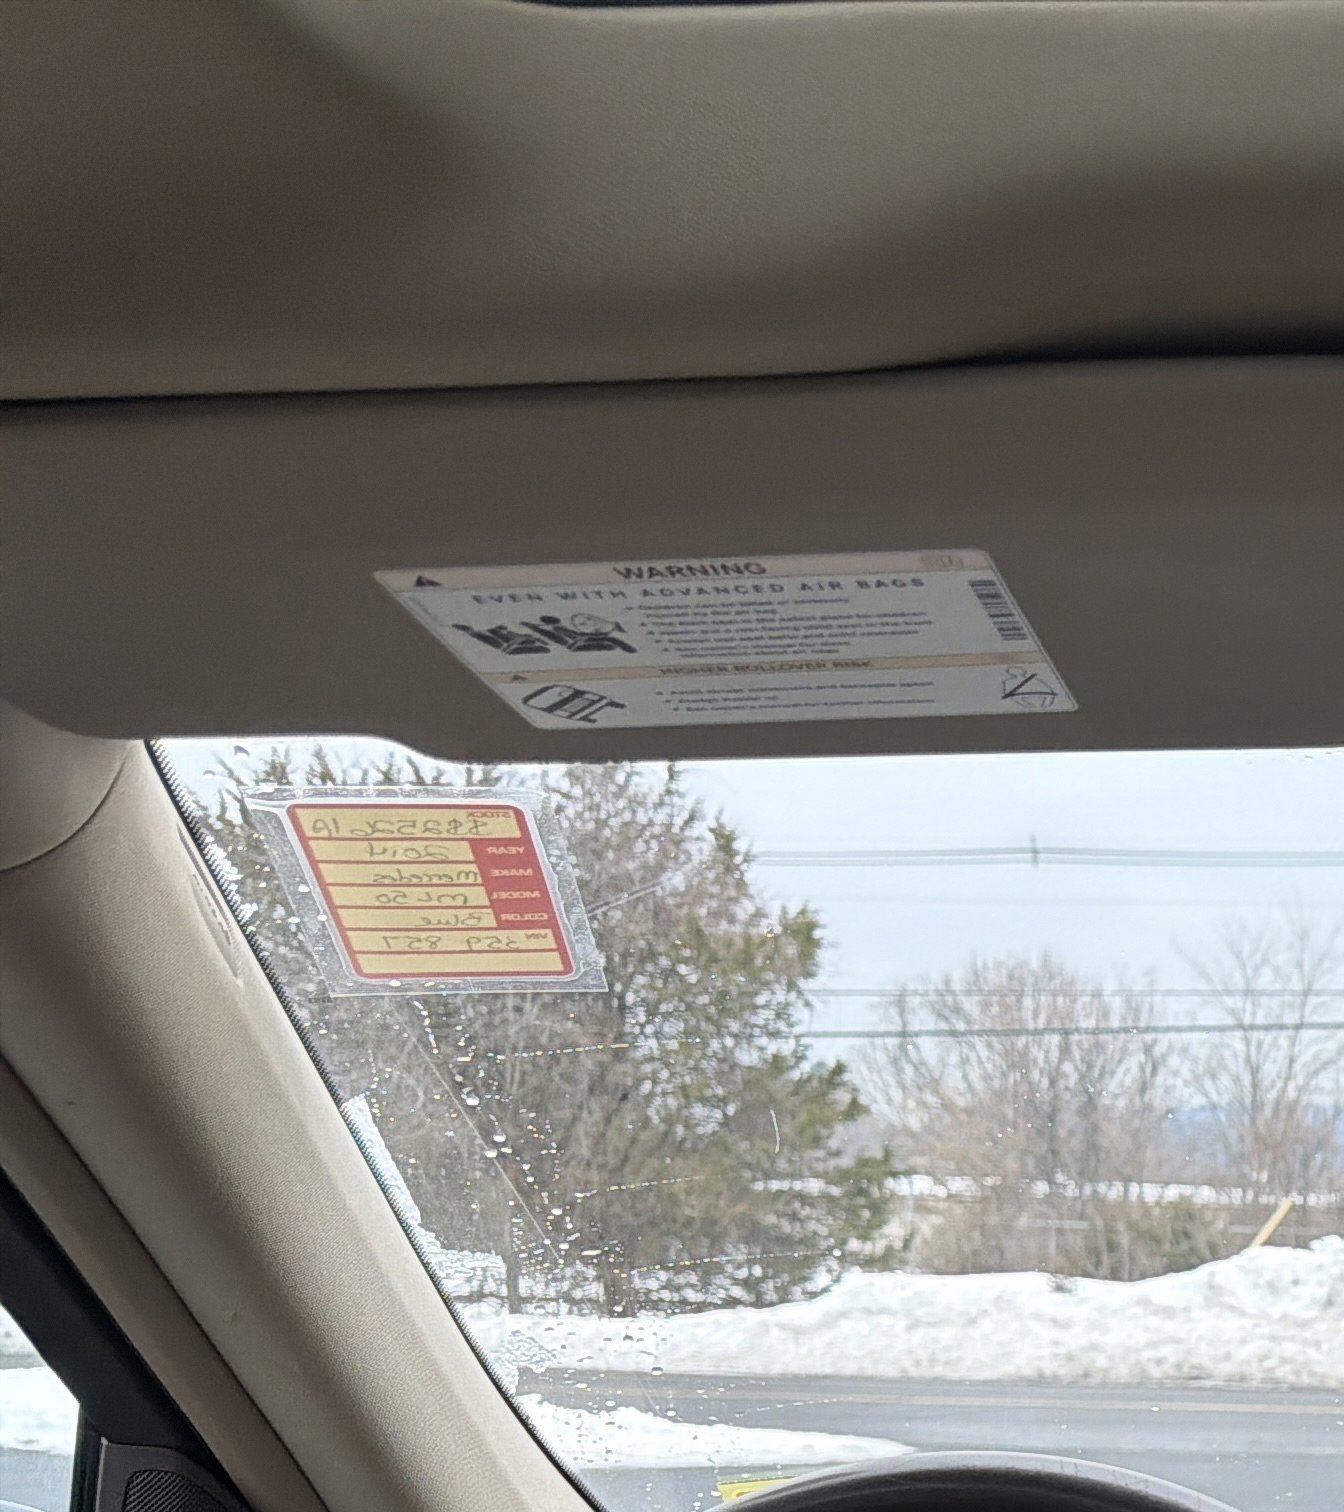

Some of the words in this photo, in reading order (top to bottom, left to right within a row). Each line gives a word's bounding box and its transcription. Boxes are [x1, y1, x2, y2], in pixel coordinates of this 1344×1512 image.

[613, 562, 767, 580] WARNING
[472, 592, 544, 604] EVEN
[556, 590, 628, 600] WITH
[642, 583, 785, 597] ADVANCED
[800, 580, 844, 592] AIR
[855, 577, 926, 590] BAGS
